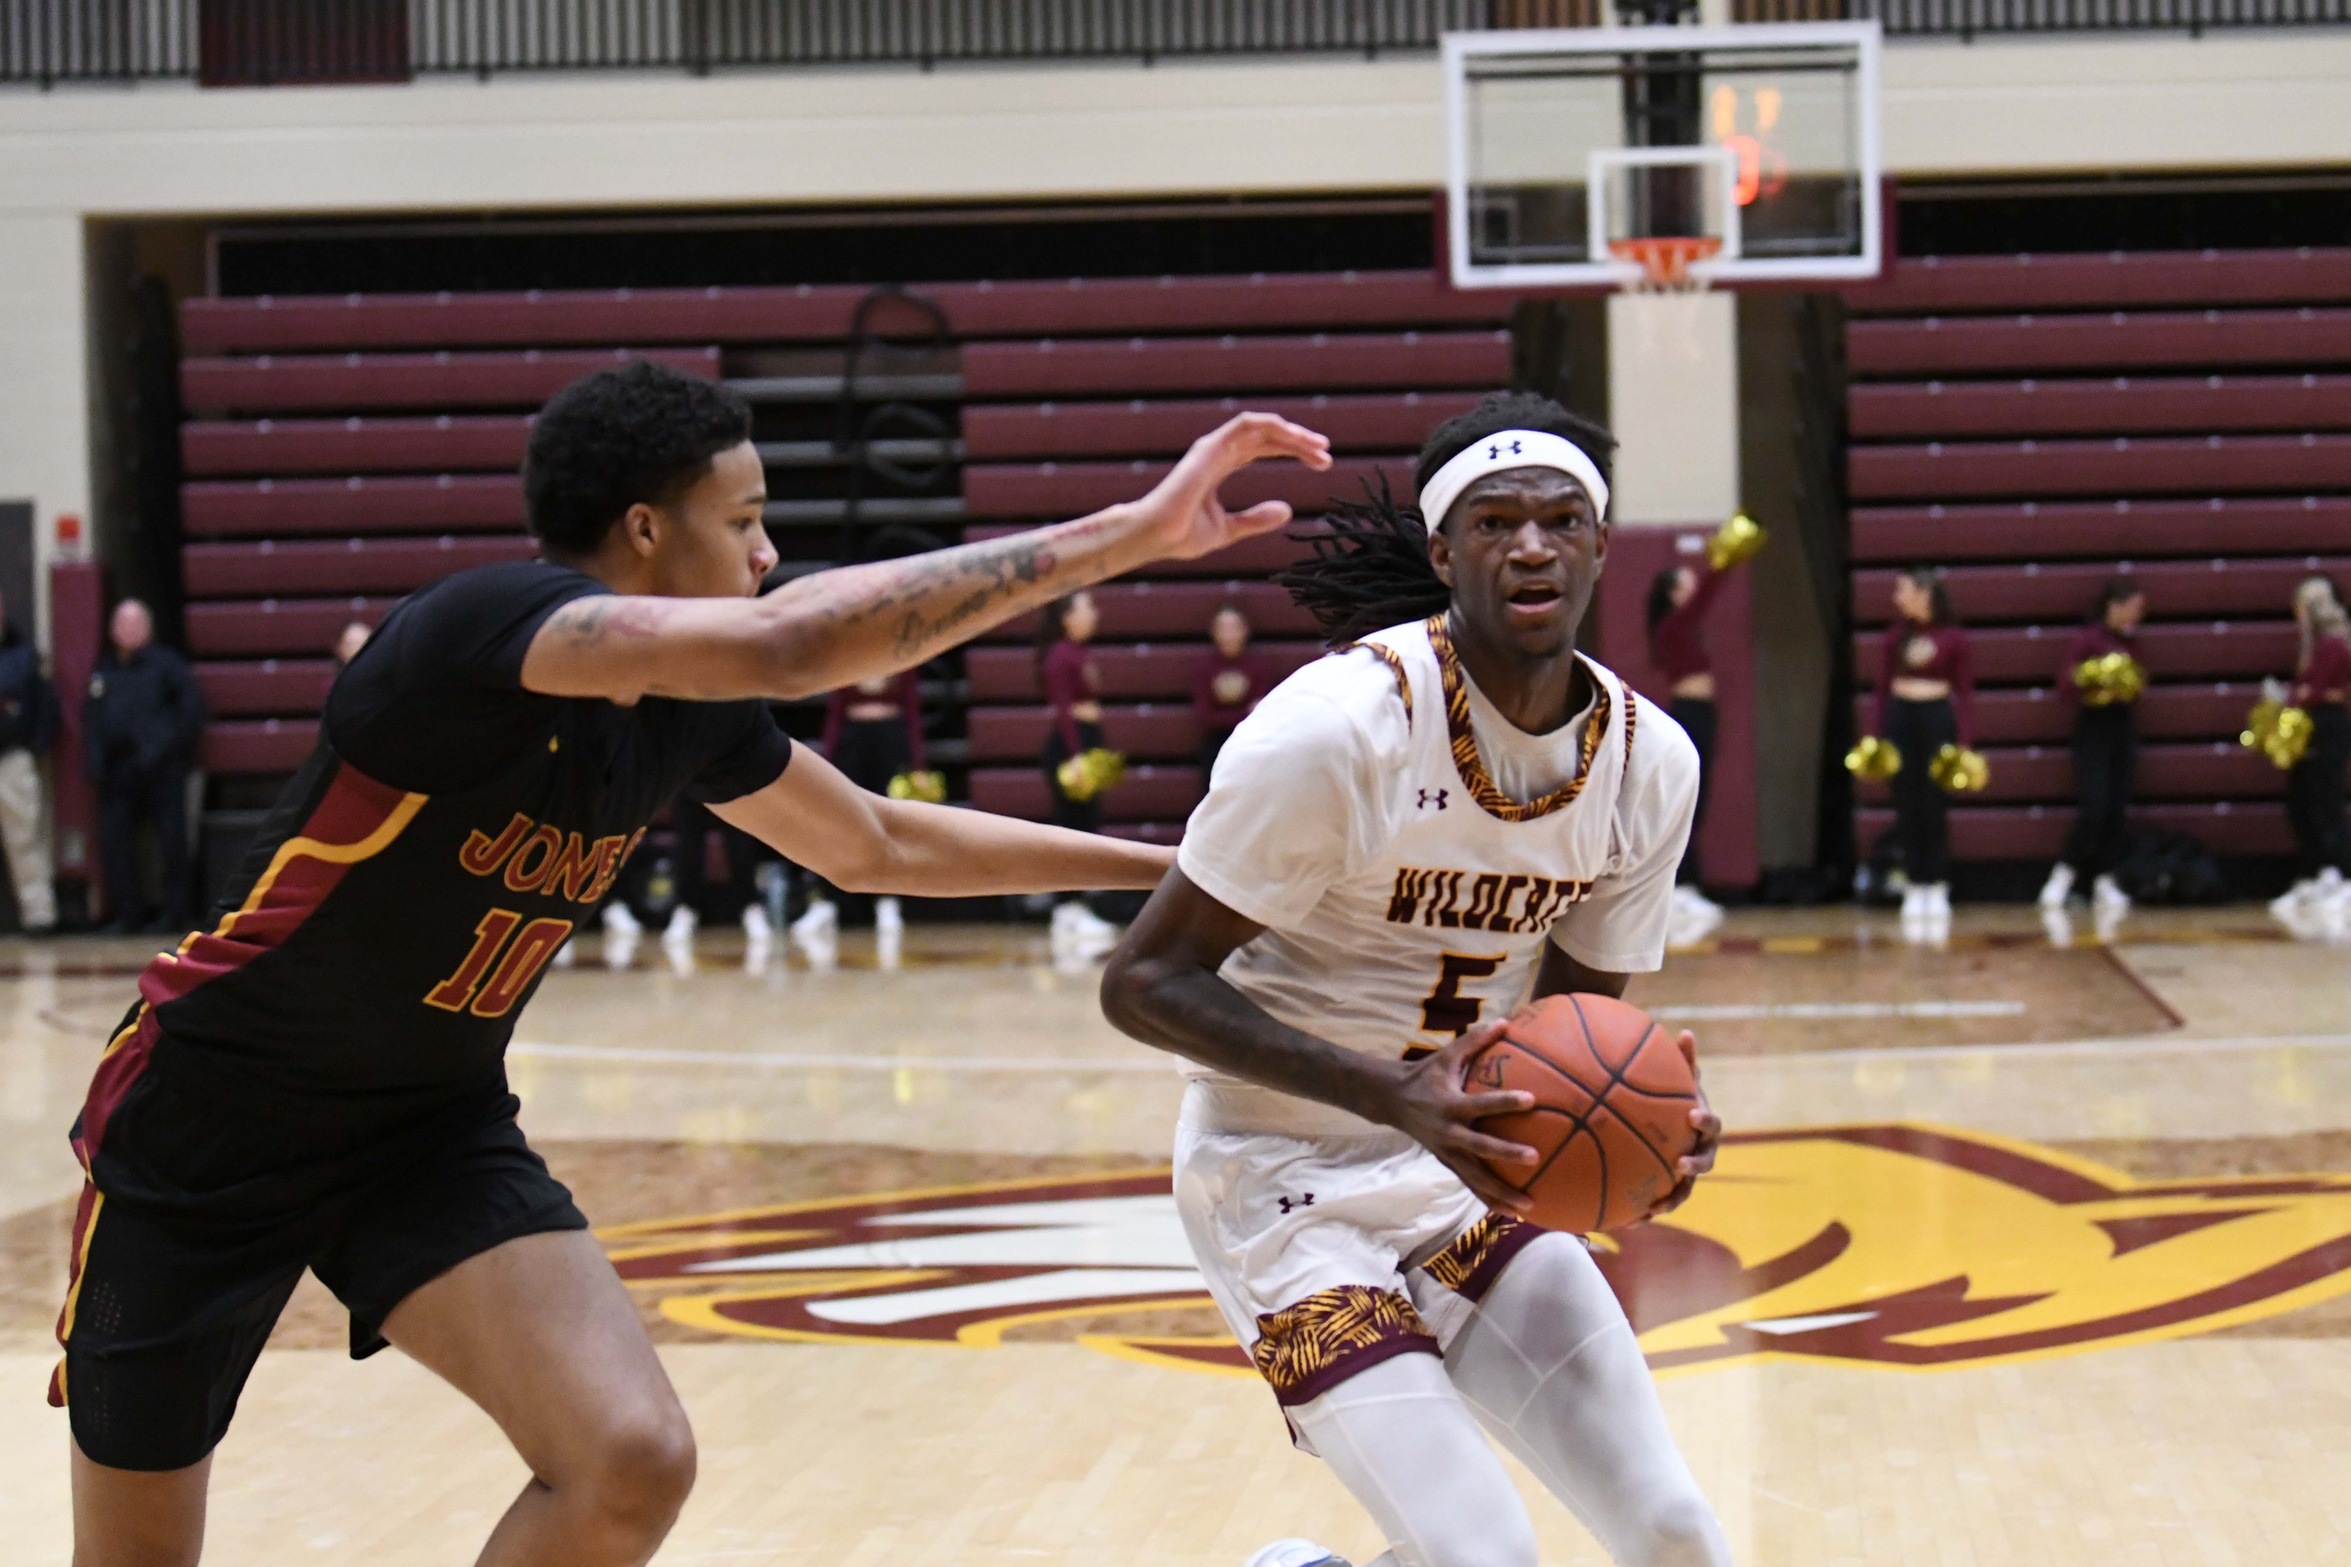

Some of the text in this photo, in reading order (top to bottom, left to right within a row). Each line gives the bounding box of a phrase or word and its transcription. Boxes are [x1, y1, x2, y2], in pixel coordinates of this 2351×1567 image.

[459, 812, 647, 903] JONE
[422, 907, 573, 1018] 10
[1401, 951, 1508, 1061] 5
